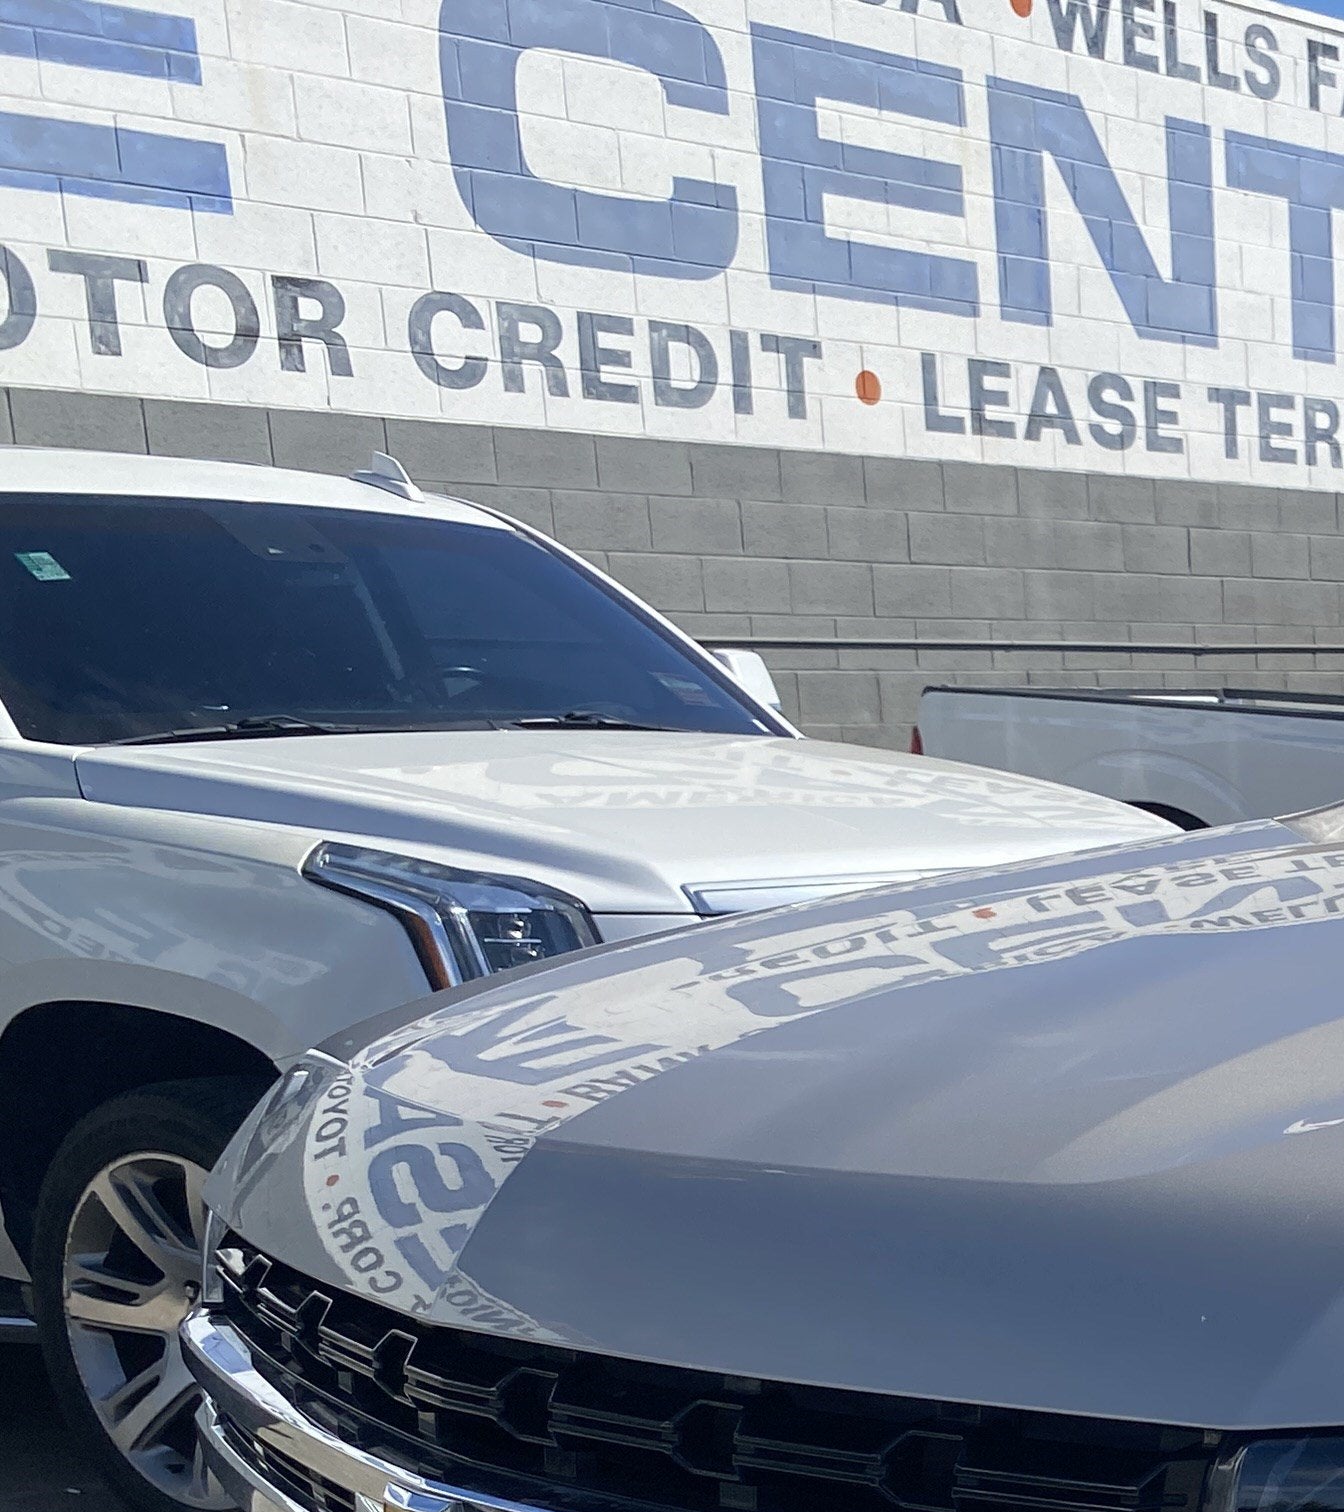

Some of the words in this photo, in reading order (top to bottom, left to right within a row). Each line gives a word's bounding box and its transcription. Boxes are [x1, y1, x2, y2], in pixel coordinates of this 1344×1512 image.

[1047, 0, 1281, 100] WELLS
[408, 291, 822, 420] CREDIT
[921, 352, 1184, 455] LEASE
